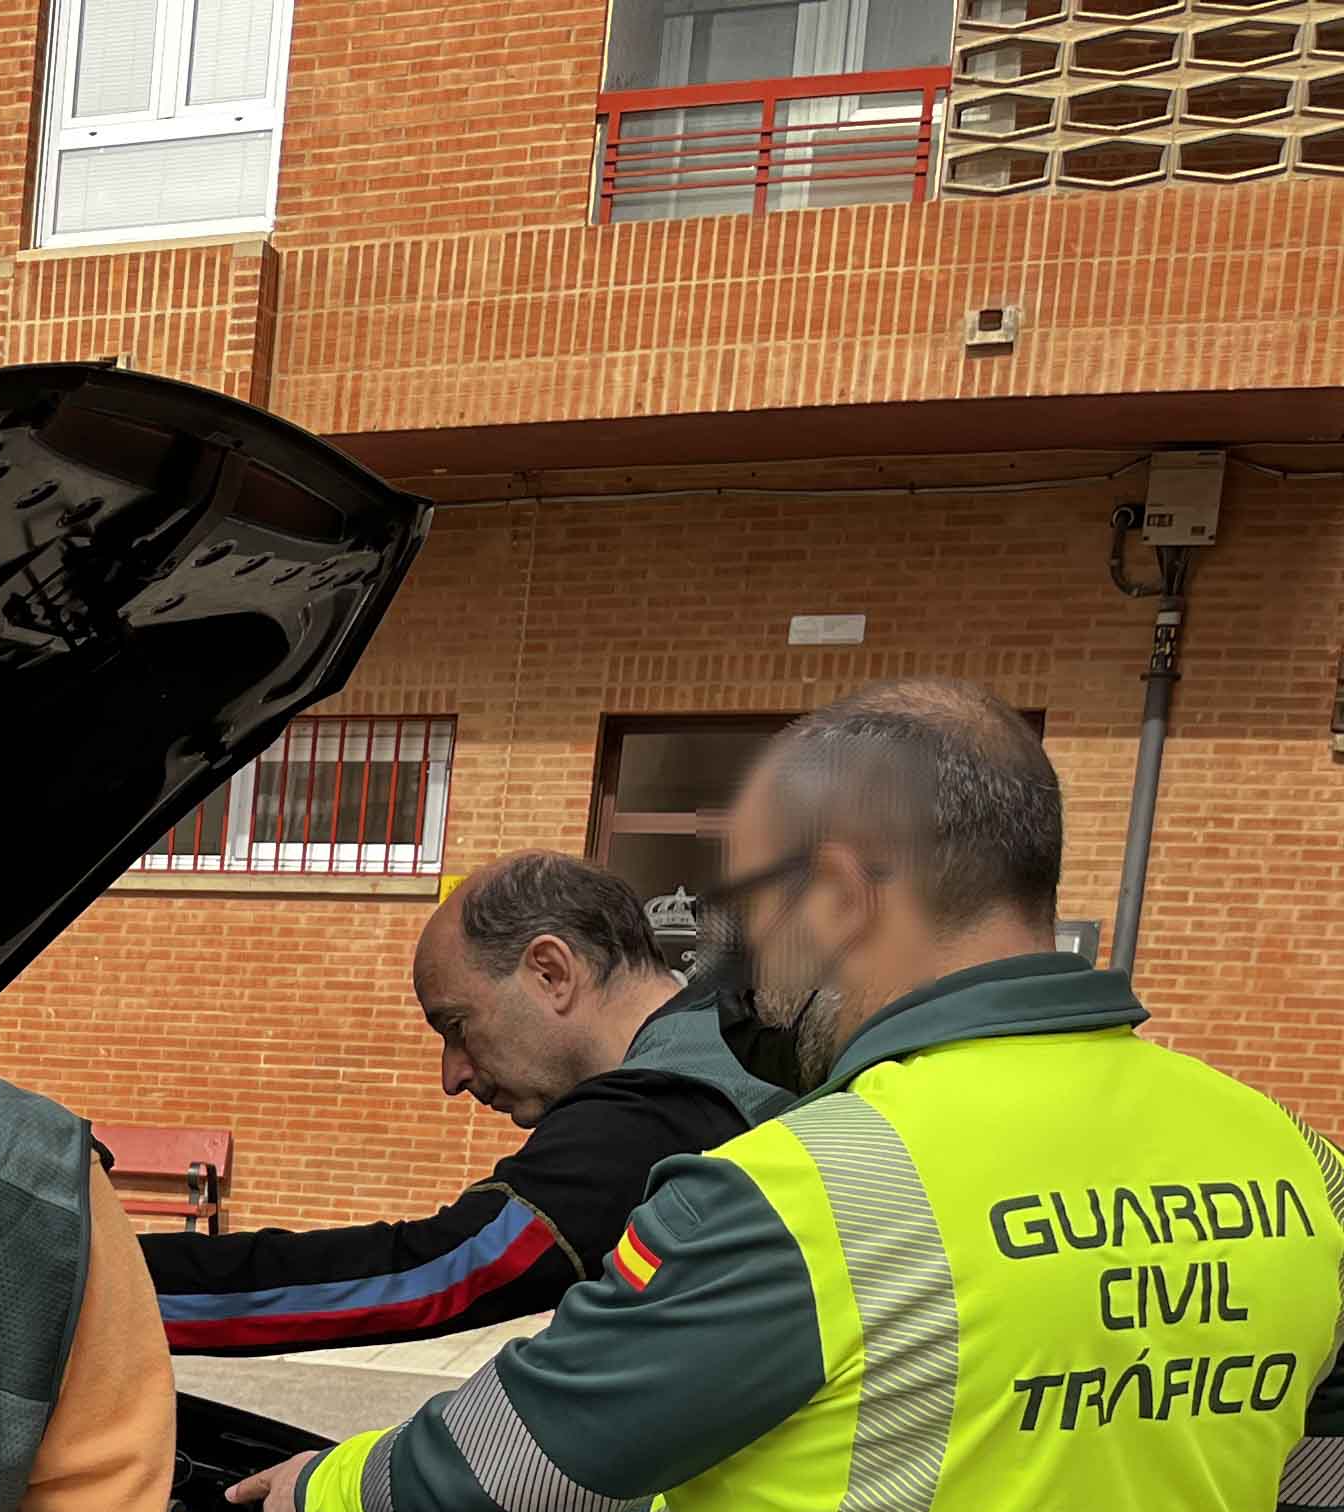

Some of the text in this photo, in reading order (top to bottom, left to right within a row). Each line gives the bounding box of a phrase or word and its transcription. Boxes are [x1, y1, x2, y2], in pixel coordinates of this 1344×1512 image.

[989, 1179, 1315, 1260] GUARDIA
[1100, 1261, 1248, 1330] CIVIL
[1014, 1347, 1297, 1431] TRÁFICO
